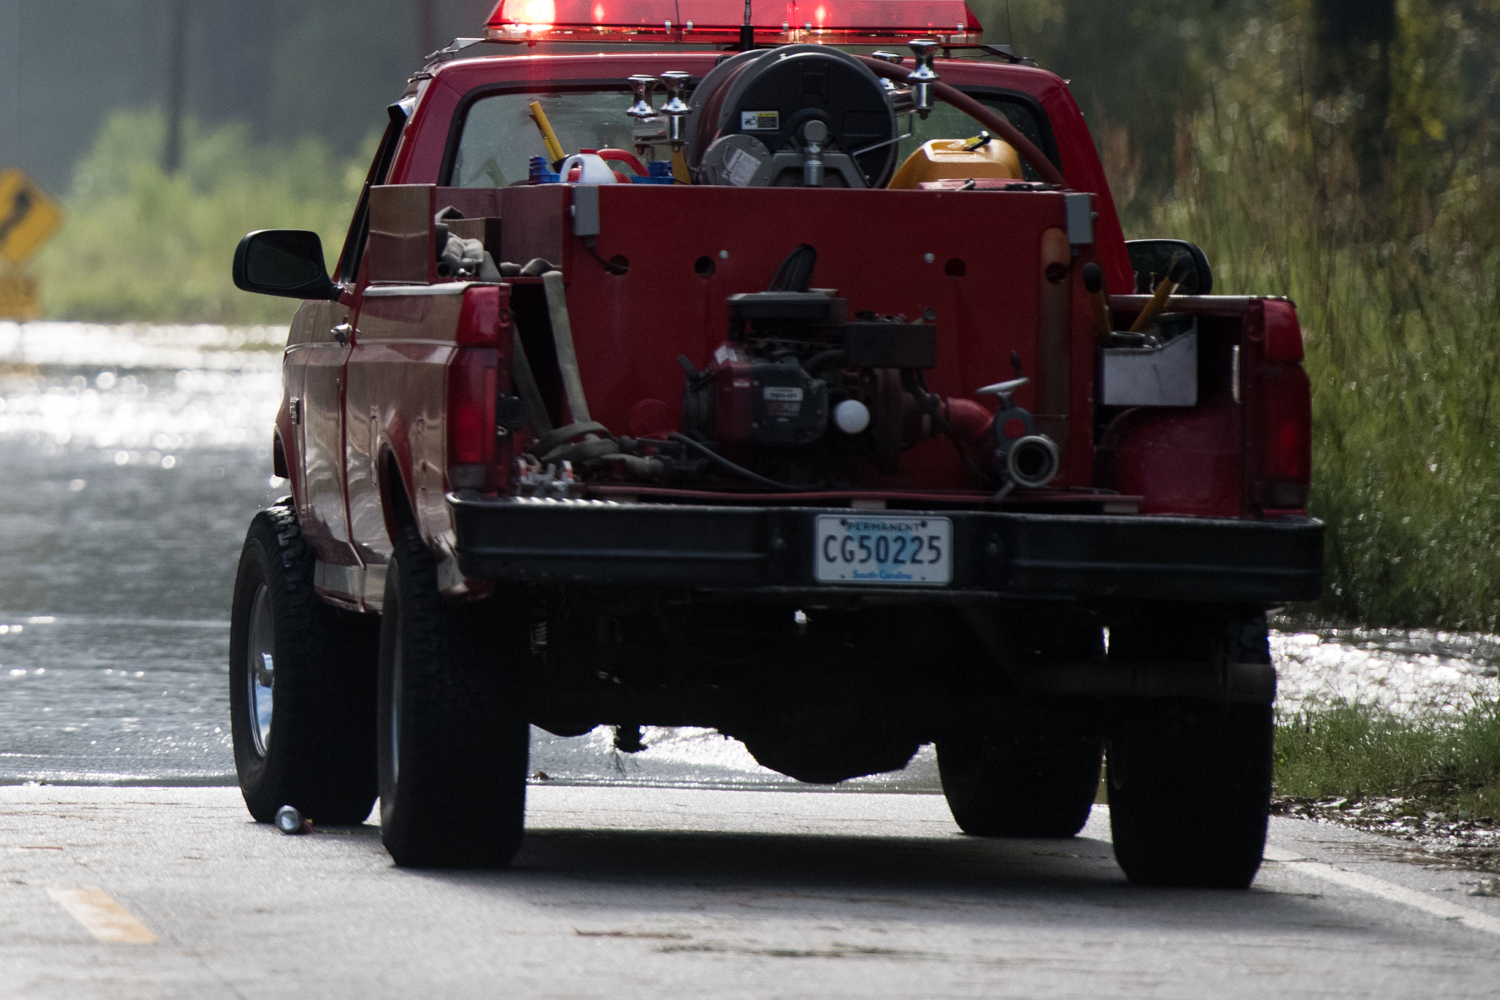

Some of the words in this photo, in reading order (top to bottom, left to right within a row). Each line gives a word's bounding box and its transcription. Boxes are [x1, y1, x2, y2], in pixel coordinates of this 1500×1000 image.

[848, 521, 920, 532] PERMANENT
[824, 534, 942, 564] CG50225
[853, 569, 878, 579] South
[879, 570, 913, 580] Carolina
